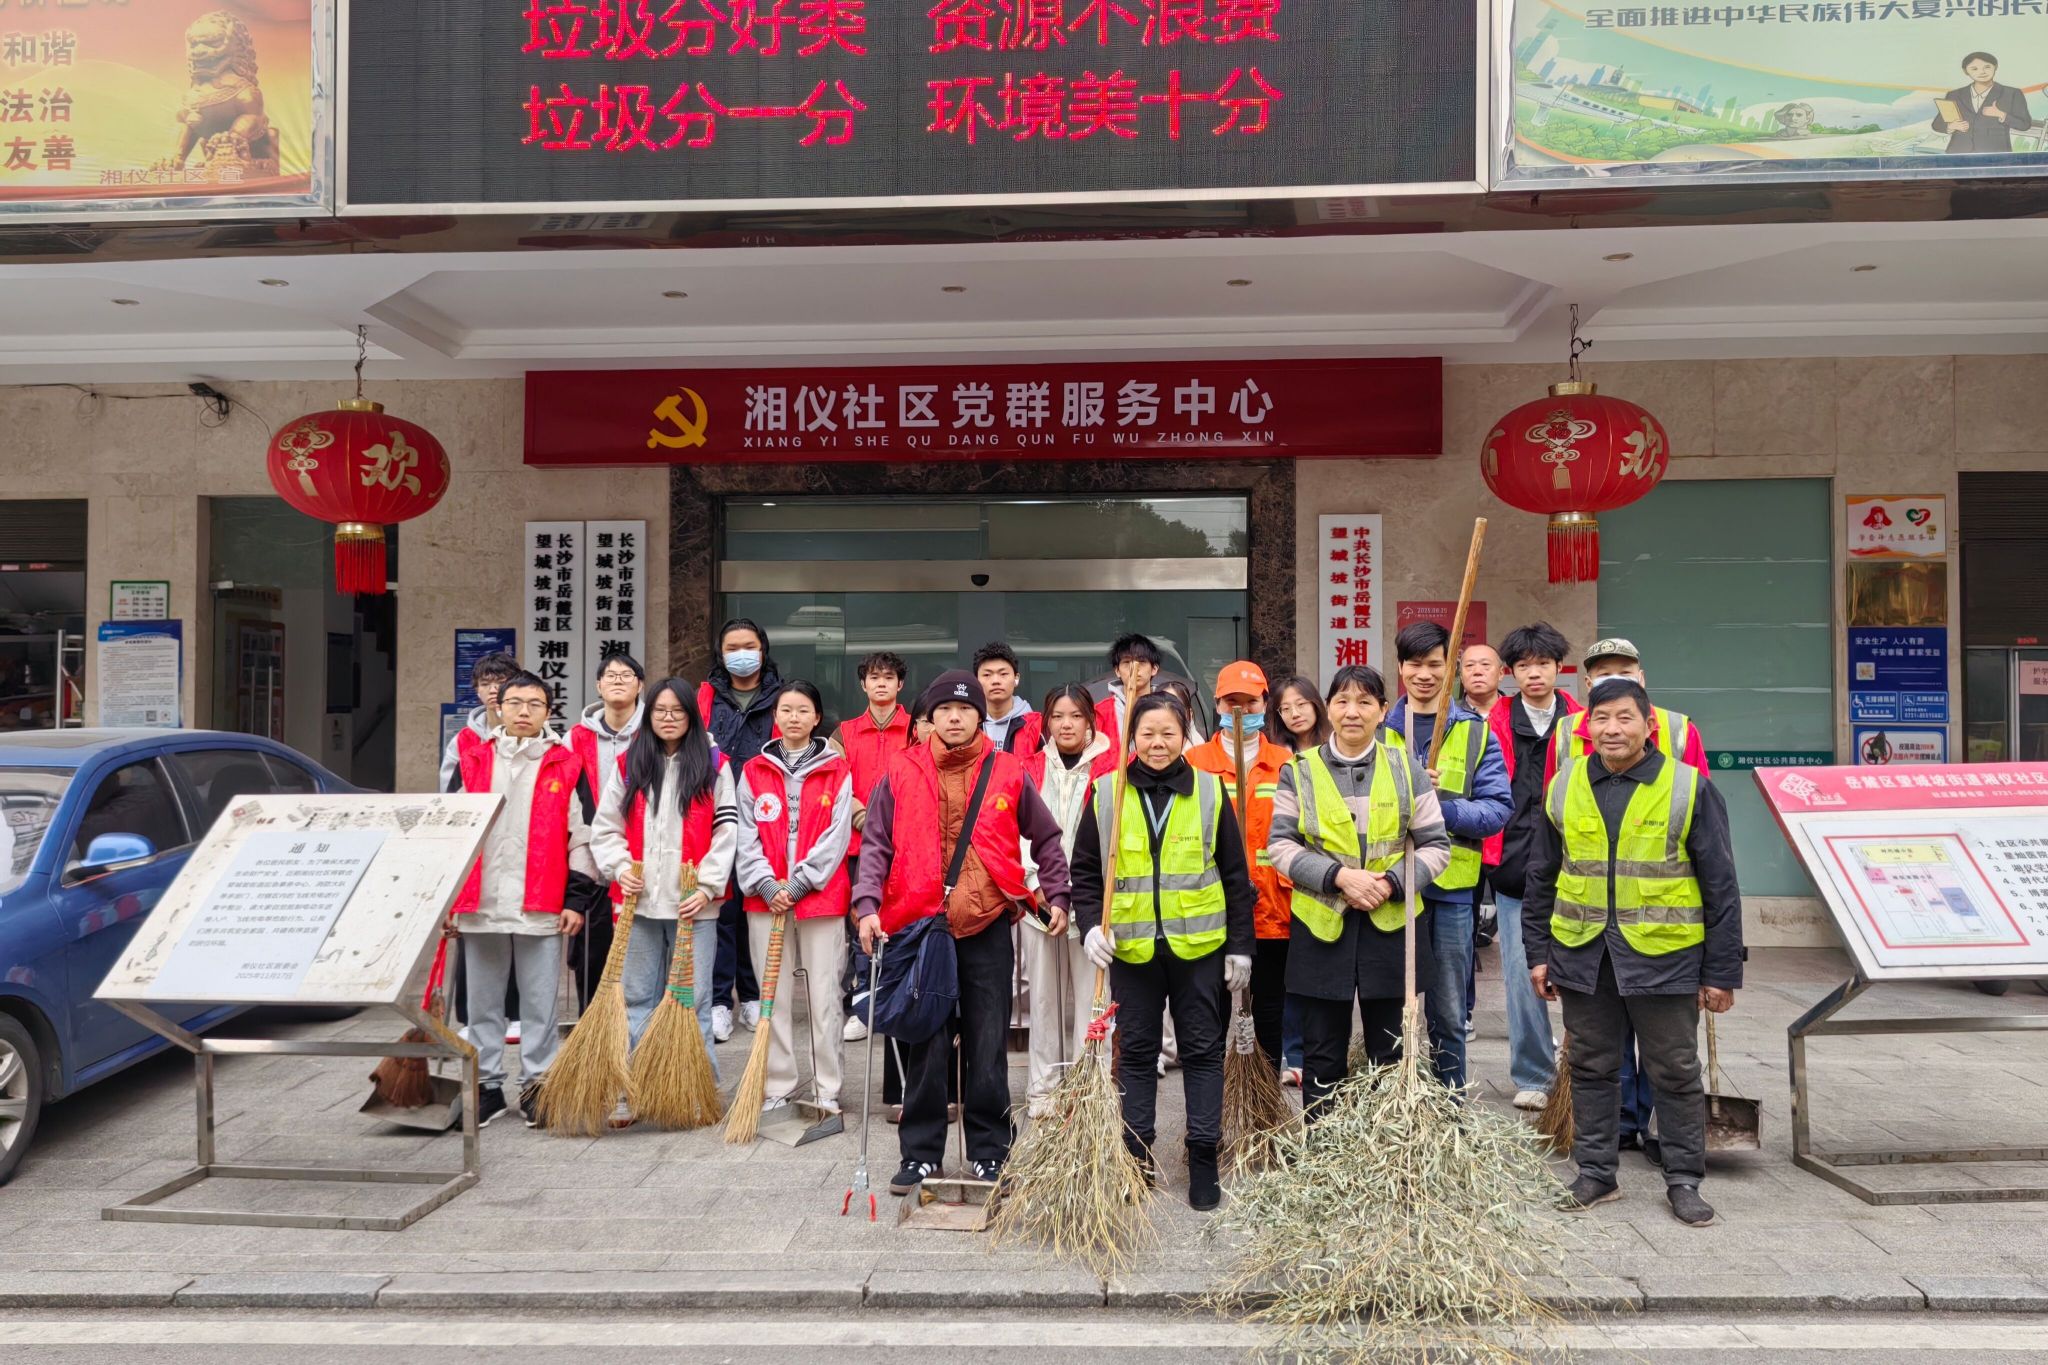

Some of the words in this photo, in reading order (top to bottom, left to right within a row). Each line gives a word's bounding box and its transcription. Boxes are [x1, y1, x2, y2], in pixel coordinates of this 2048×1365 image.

[521, 0, 866, 59] 垃圾分好类
[927, 0, 1281, 52] 资源不浪费
[1585, 0, 2048, 28] 全面推进中华民族伟大复兴的长
[3, 31, 76, 67] 和谐
[0, 87, 73, 122] 法治
[521, 80, 866, 151] 垃圾分一分
[926, 67, 1283, 144] 环境美十分
[4, 135, 76, 171] 友善
[100, 168, 207, 185] 湘仪社区
[218, 168, 243, 184] 宣
[744, 378, 1274, 432] 湘仪社区党群服务中心
[360, 431, 422, 496] 欢
[744, 436, 802, 447] XIANG
[820, 435, 838, 447] YI
[855, 435, 889, 447] SHE
[907, 434, 932, 447] QU
[949, 434, 999, 446] DANG
[1017, 433, 1056, 445] QUN
[1073, 433, 1095, 445] FU
[1112, 432, 1140, 444] WU
[1157, 431, 1224, 444] ZHONG
[1242, 430, 1275, 442] XIN
[534, 534, 552, 632] 望城坡街道
[556, 534, 573, 631] 长沙市岳麓区
[595, 533, 613, 632] 望城坡街道
[617, 533, 635, 631] 长沙市岳麓区
[1330, 527, 1348, 629] 望城坡街道
[1353, 526, 1371, 629] 中共长沙市岳麓区
[1335, 638, 1368, 667] 湘
[1738, 756, 1823, 765] 湘仪社区公共服务中心
[288, 843, 330, 853] 通知
